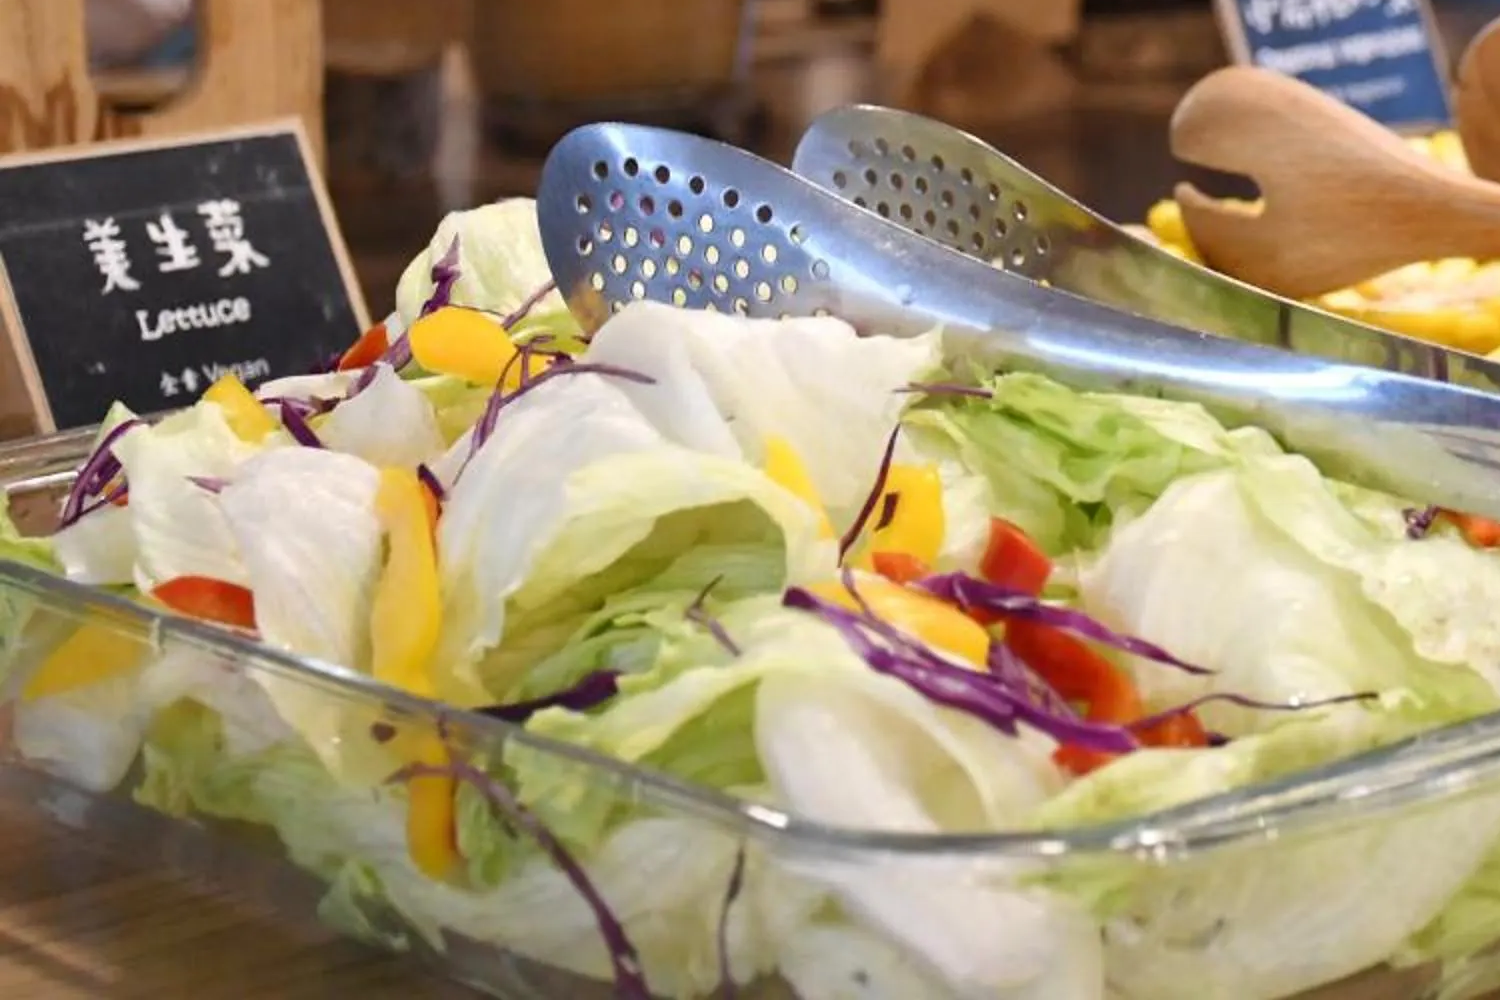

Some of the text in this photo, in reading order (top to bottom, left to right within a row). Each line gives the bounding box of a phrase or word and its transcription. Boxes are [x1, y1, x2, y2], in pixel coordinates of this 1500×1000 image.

[83, 199, 271, 294] 美生菜
[135, 296, 252, 341] Lettuce
